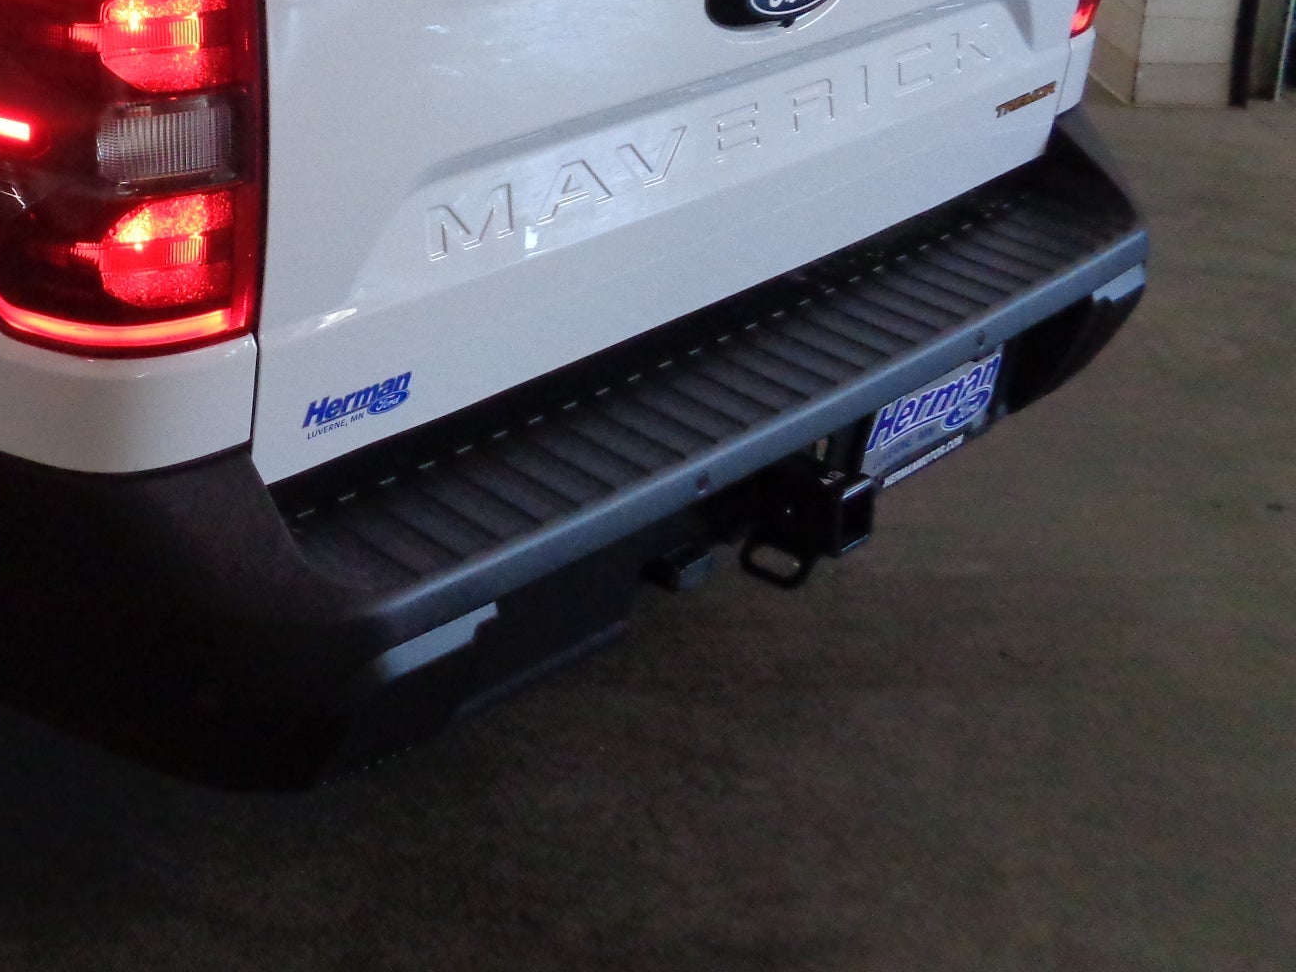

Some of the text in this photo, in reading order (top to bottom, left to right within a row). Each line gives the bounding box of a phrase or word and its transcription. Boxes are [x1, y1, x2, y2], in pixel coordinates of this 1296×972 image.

[427, 22, 993, 262] MAVERICK
[302, 370, 412, 428] Herman
[350, 411, 365, 423] MN
[866, 352, 1002, 452] Herman
